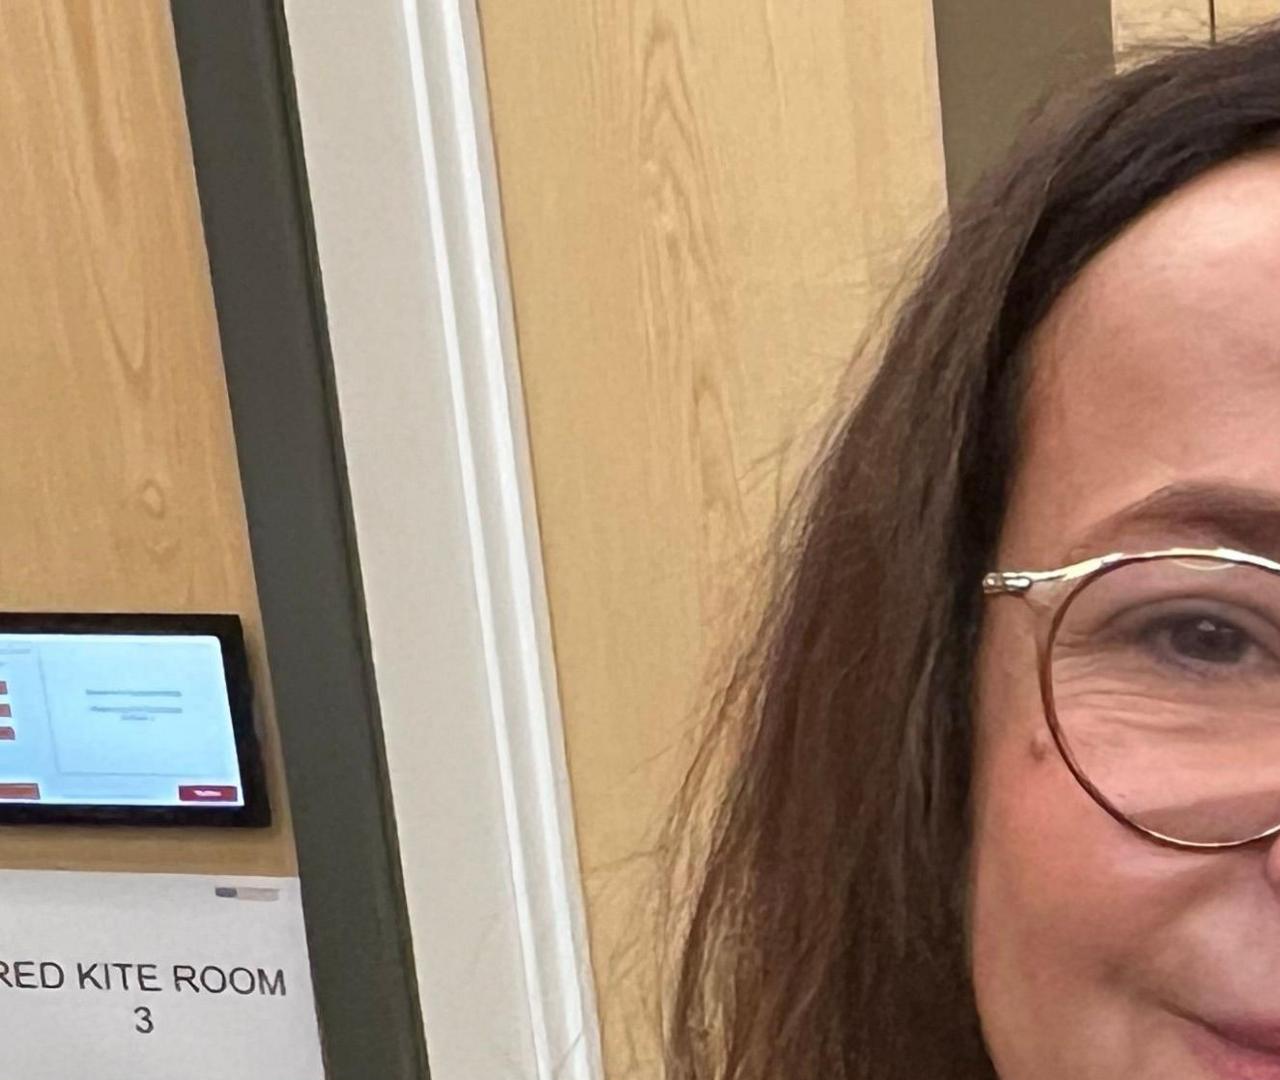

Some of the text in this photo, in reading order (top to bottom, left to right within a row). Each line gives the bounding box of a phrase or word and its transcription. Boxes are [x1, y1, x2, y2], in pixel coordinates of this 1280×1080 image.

[77, 962, 163, 992] KITE
[173, 965, 287, 996] ROOM
[133, 1006, 155, 1034] 3
